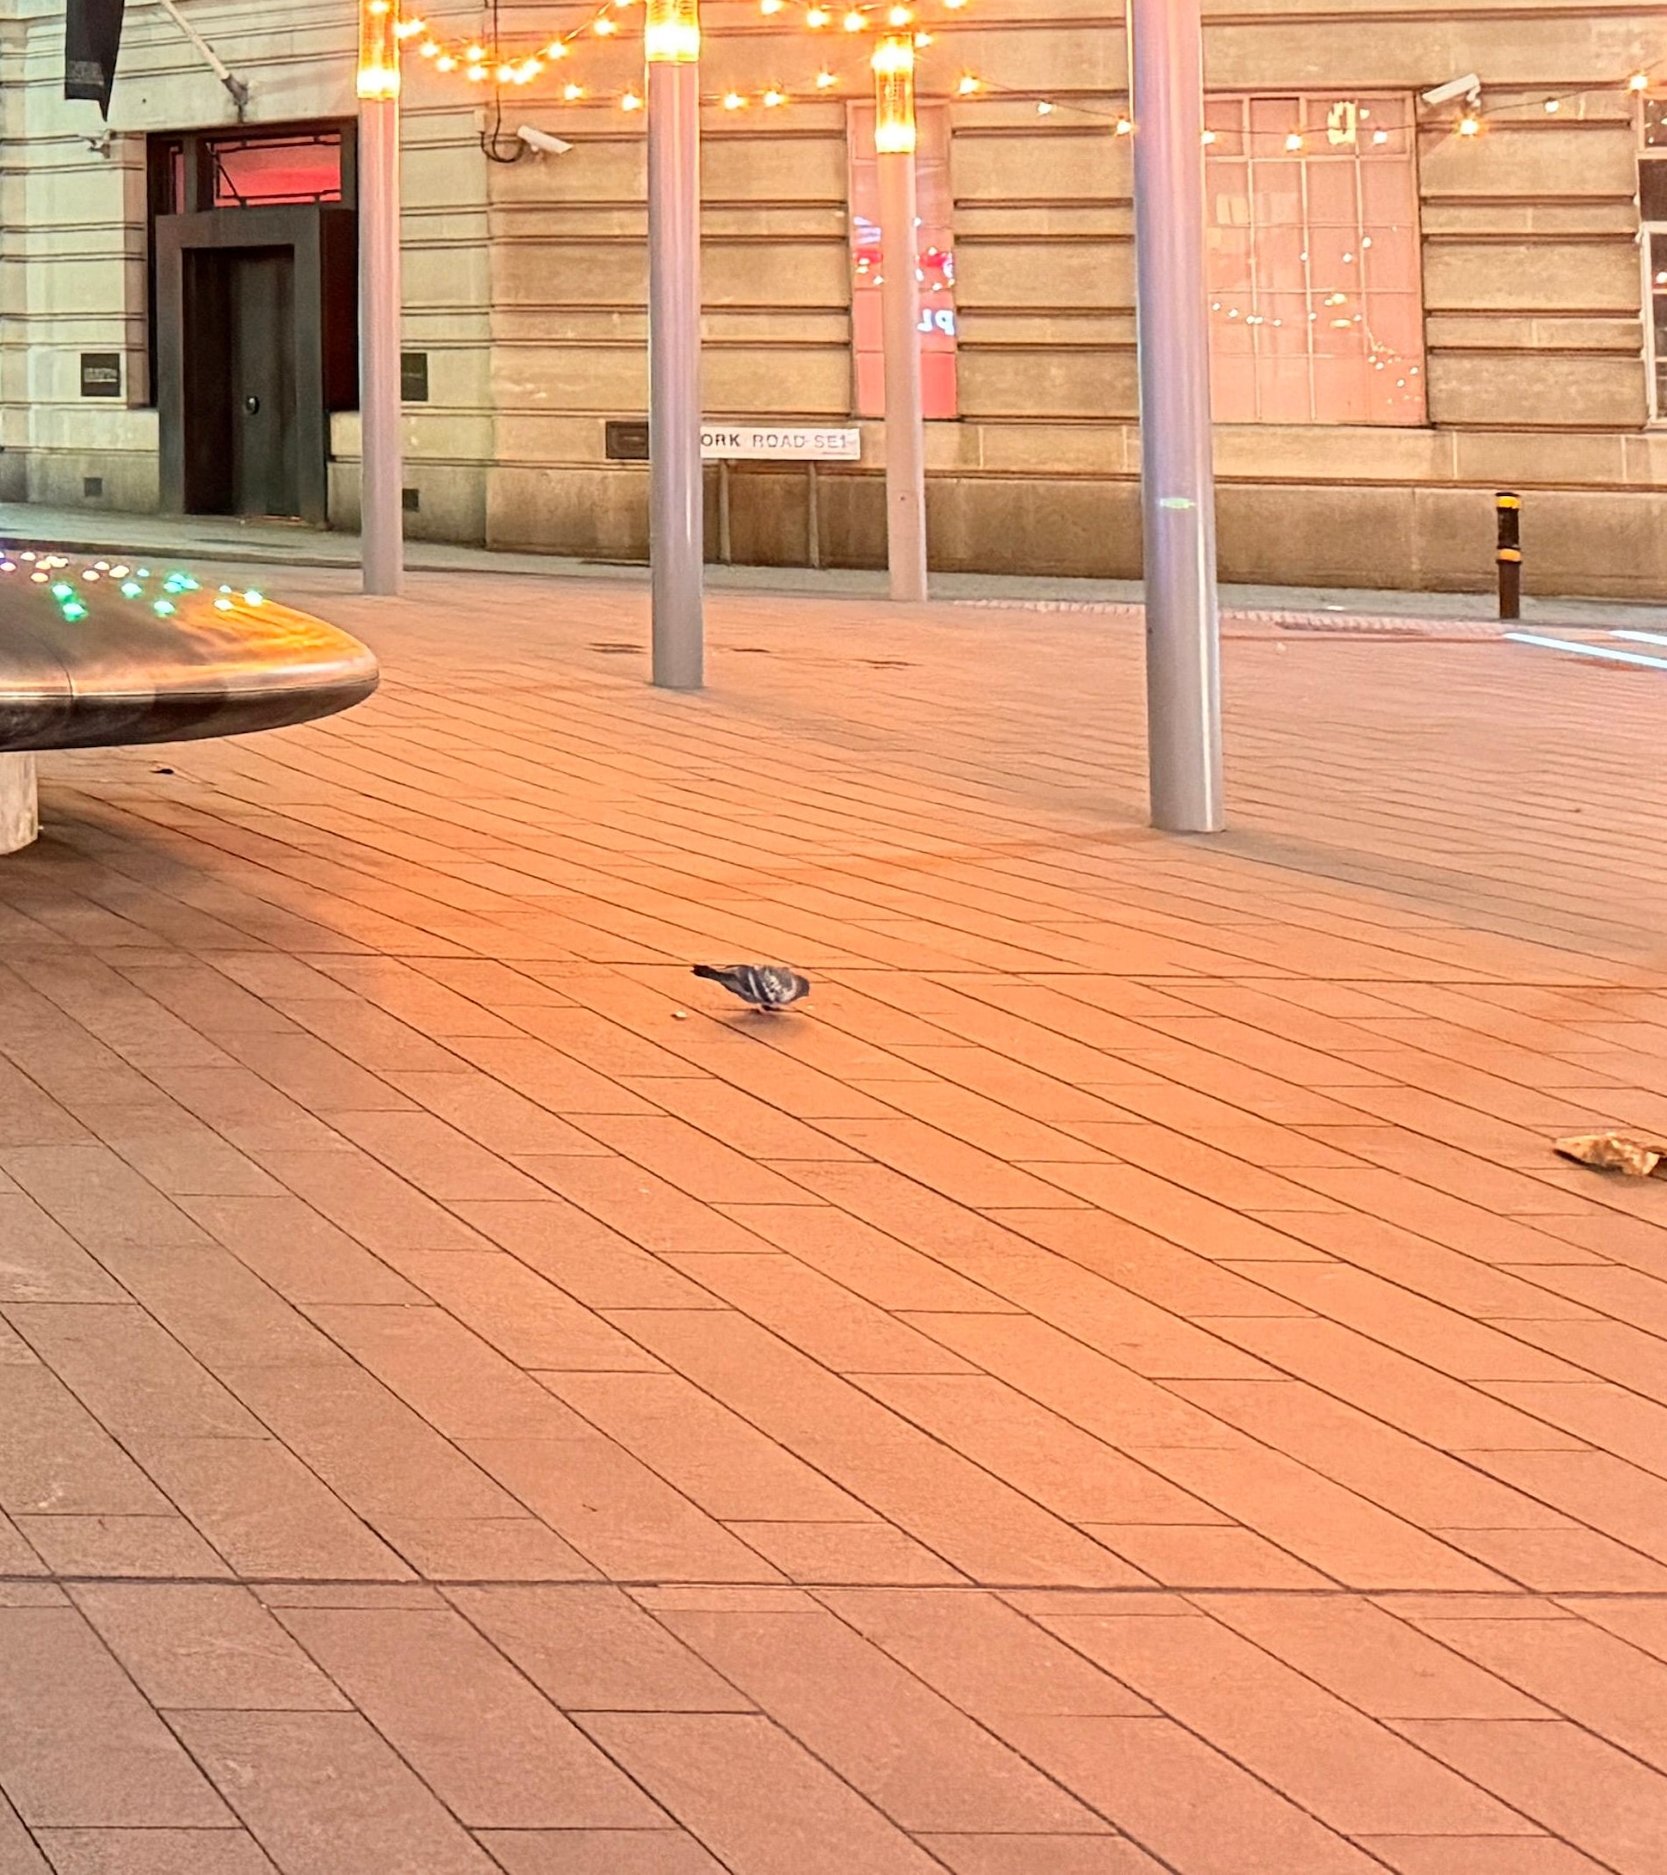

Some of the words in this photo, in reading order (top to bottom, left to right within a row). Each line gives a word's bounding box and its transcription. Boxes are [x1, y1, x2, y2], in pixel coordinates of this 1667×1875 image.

[700, 433, 741, 447] ORK
[752, 434, 806, 448] ROAD
[814, 435, 848, 449] SE1
